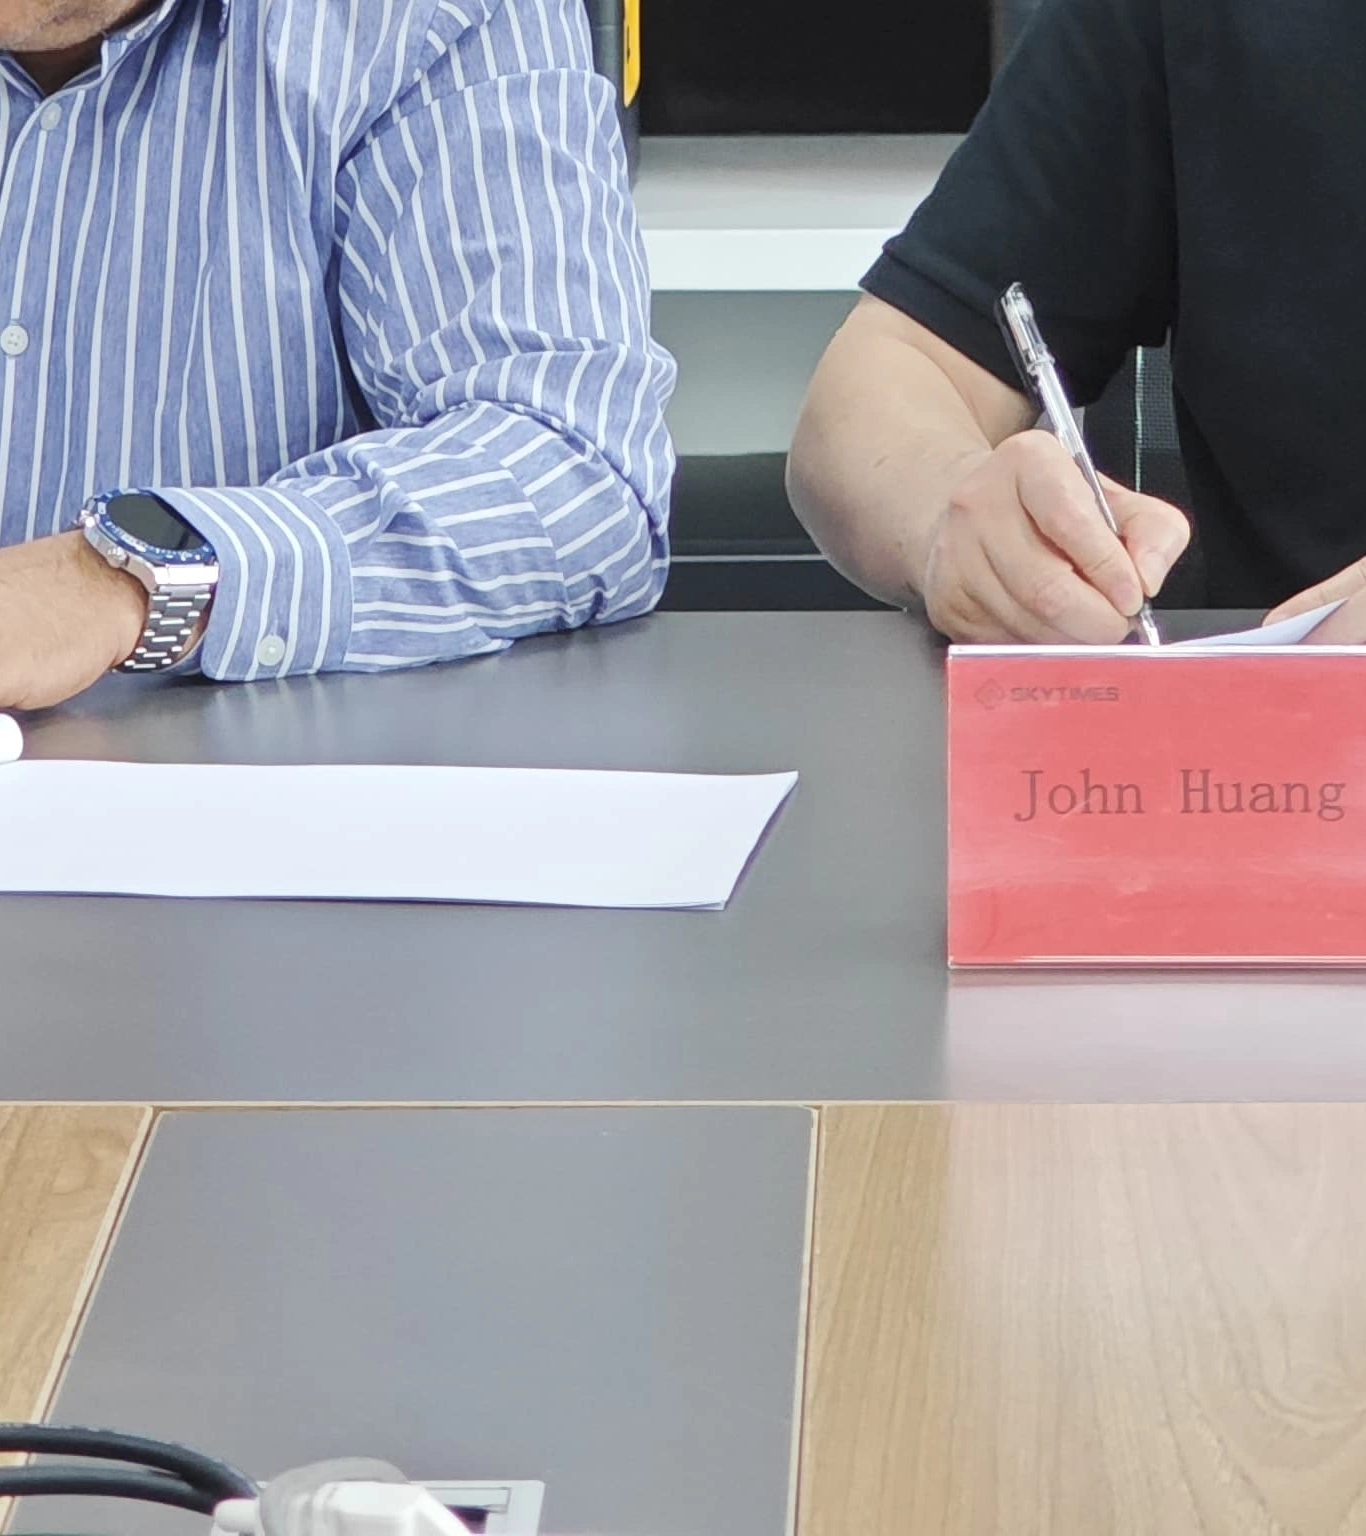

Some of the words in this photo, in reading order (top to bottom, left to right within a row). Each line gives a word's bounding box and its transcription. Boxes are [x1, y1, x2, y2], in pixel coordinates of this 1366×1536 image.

[1010, 686, 1120, 702] SKYTIMES
[1014, 769, 1146, 822] John
[1180, 768, 1347, 822] Huang
